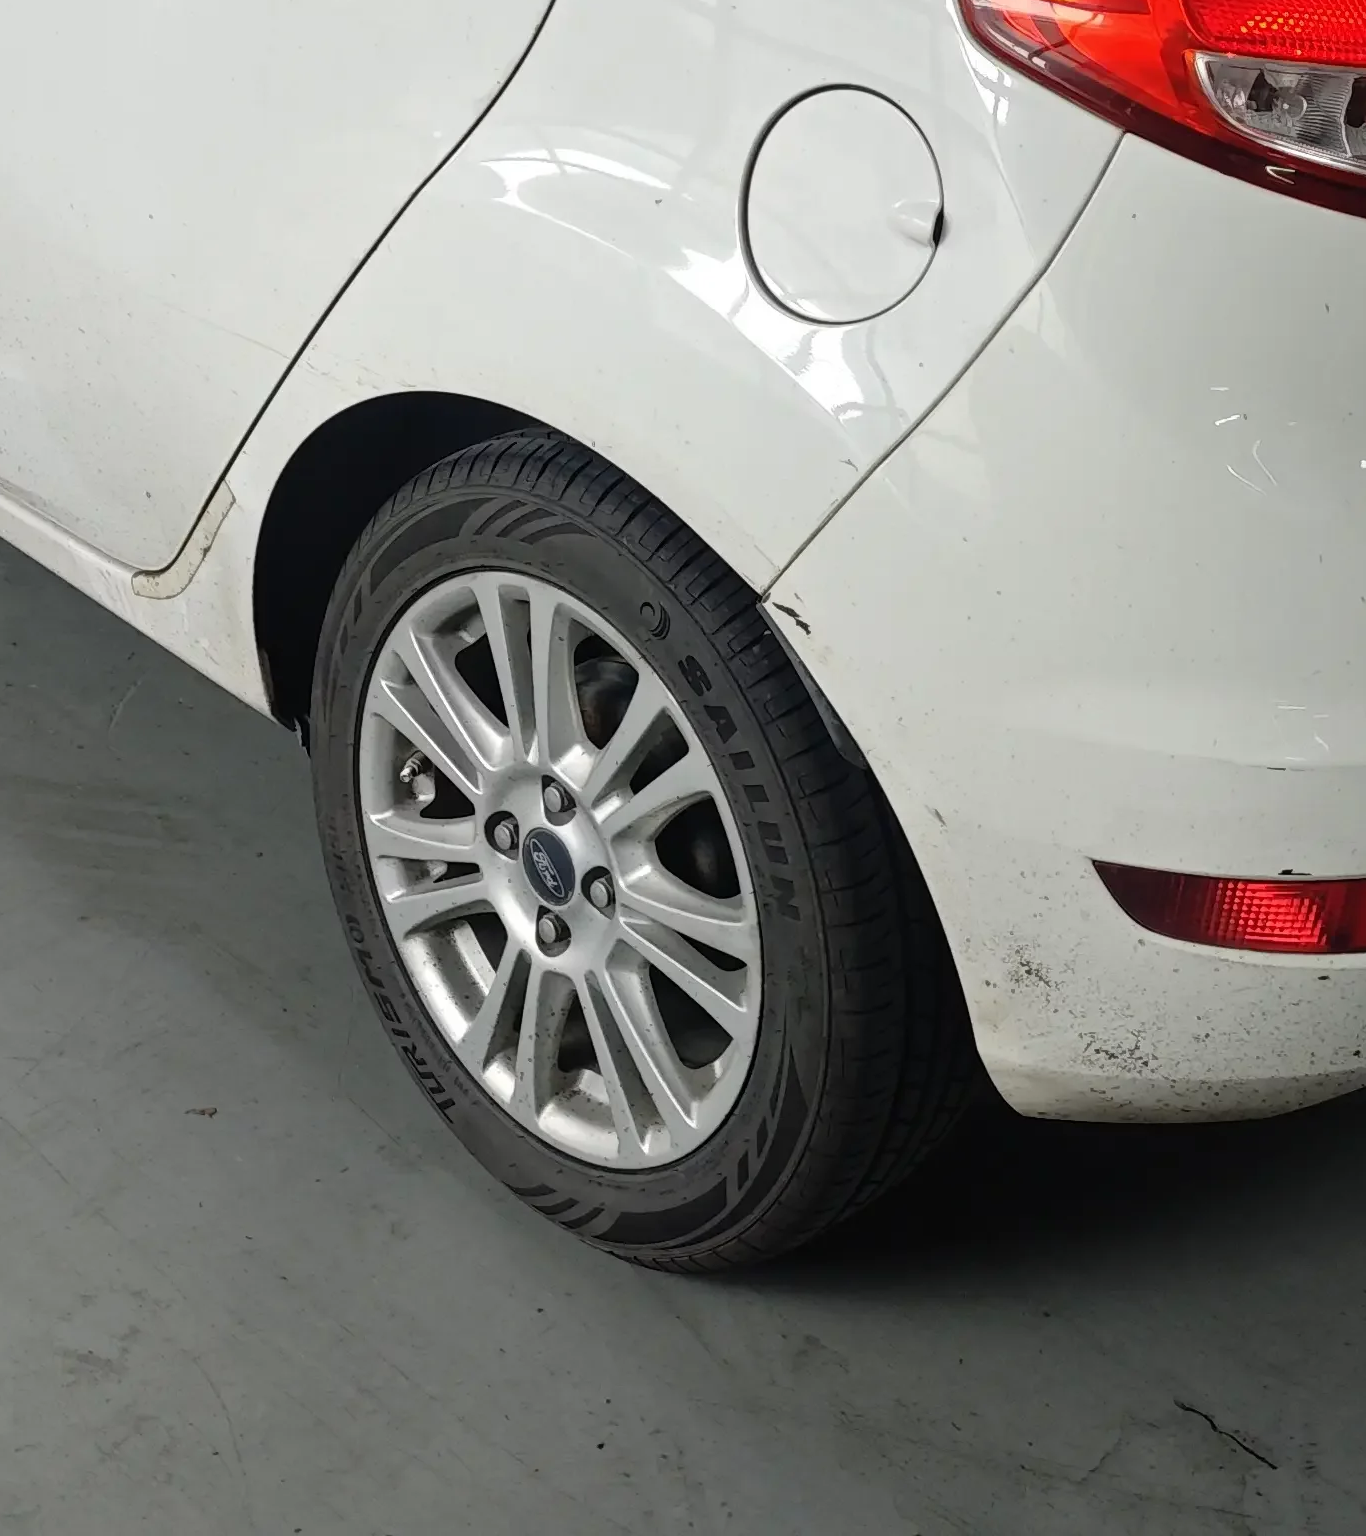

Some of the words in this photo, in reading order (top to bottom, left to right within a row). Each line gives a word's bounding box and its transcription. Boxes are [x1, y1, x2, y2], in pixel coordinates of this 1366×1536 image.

[533, 850, 558, 888] Ford
[677, 654, 802, 922] SAILUN
[346, 914, 455, 1124] TURISMO
